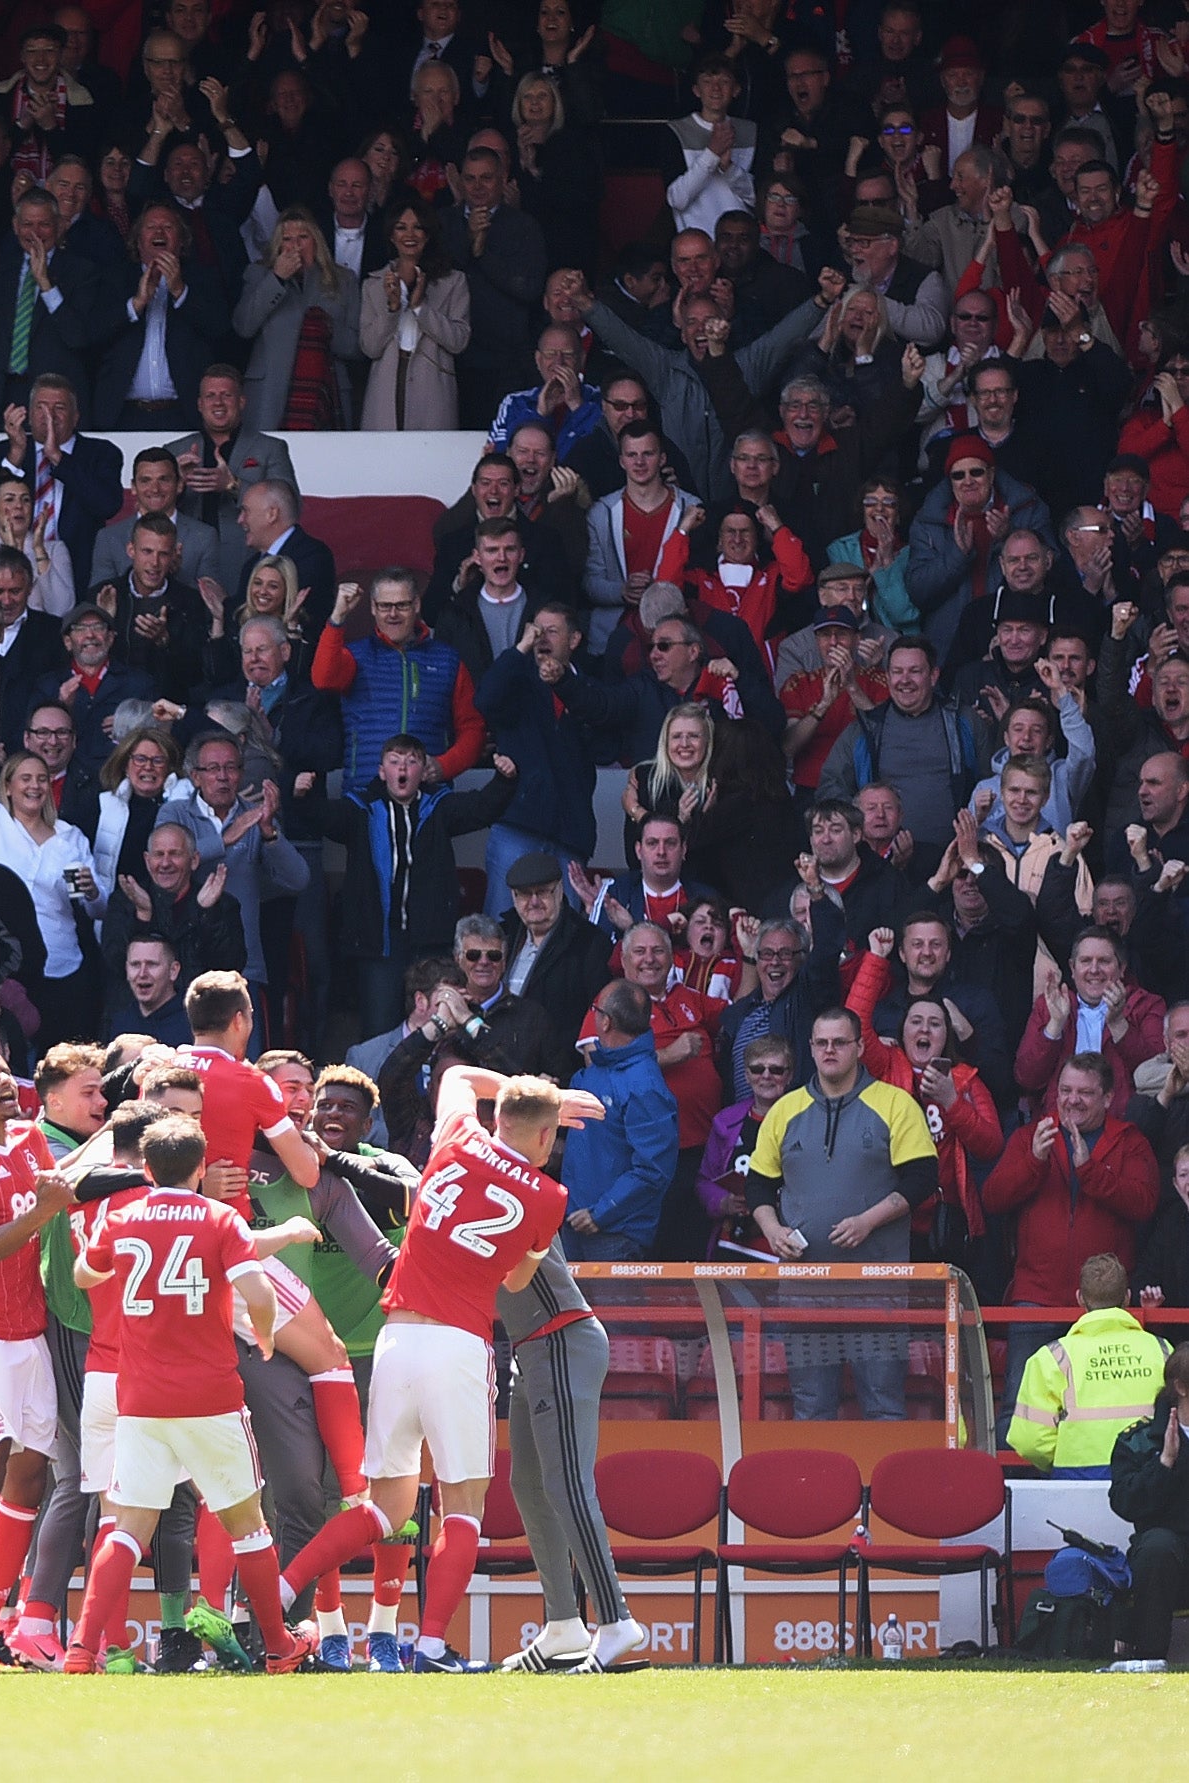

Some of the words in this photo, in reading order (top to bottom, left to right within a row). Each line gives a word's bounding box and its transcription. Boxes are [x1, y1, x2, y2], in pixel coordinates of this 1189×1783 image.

[420, 1162, 525, 1258] 42
[114, 1235, 210, 1316] 24
[611, 1265, 664, 1276] 888SPORT
[694, 1265, 747, 1276] 888SPORT
[778, 1266, 831, 1277] 888SPORT
[861, 1266, 915, 1277] 888SPORT
[1099, 1344, 1131, 1354] NFFC
[1090, 1355, 1143, 1368] SAFETY
[1085, 1367, 1153, 1381] STEWARD
